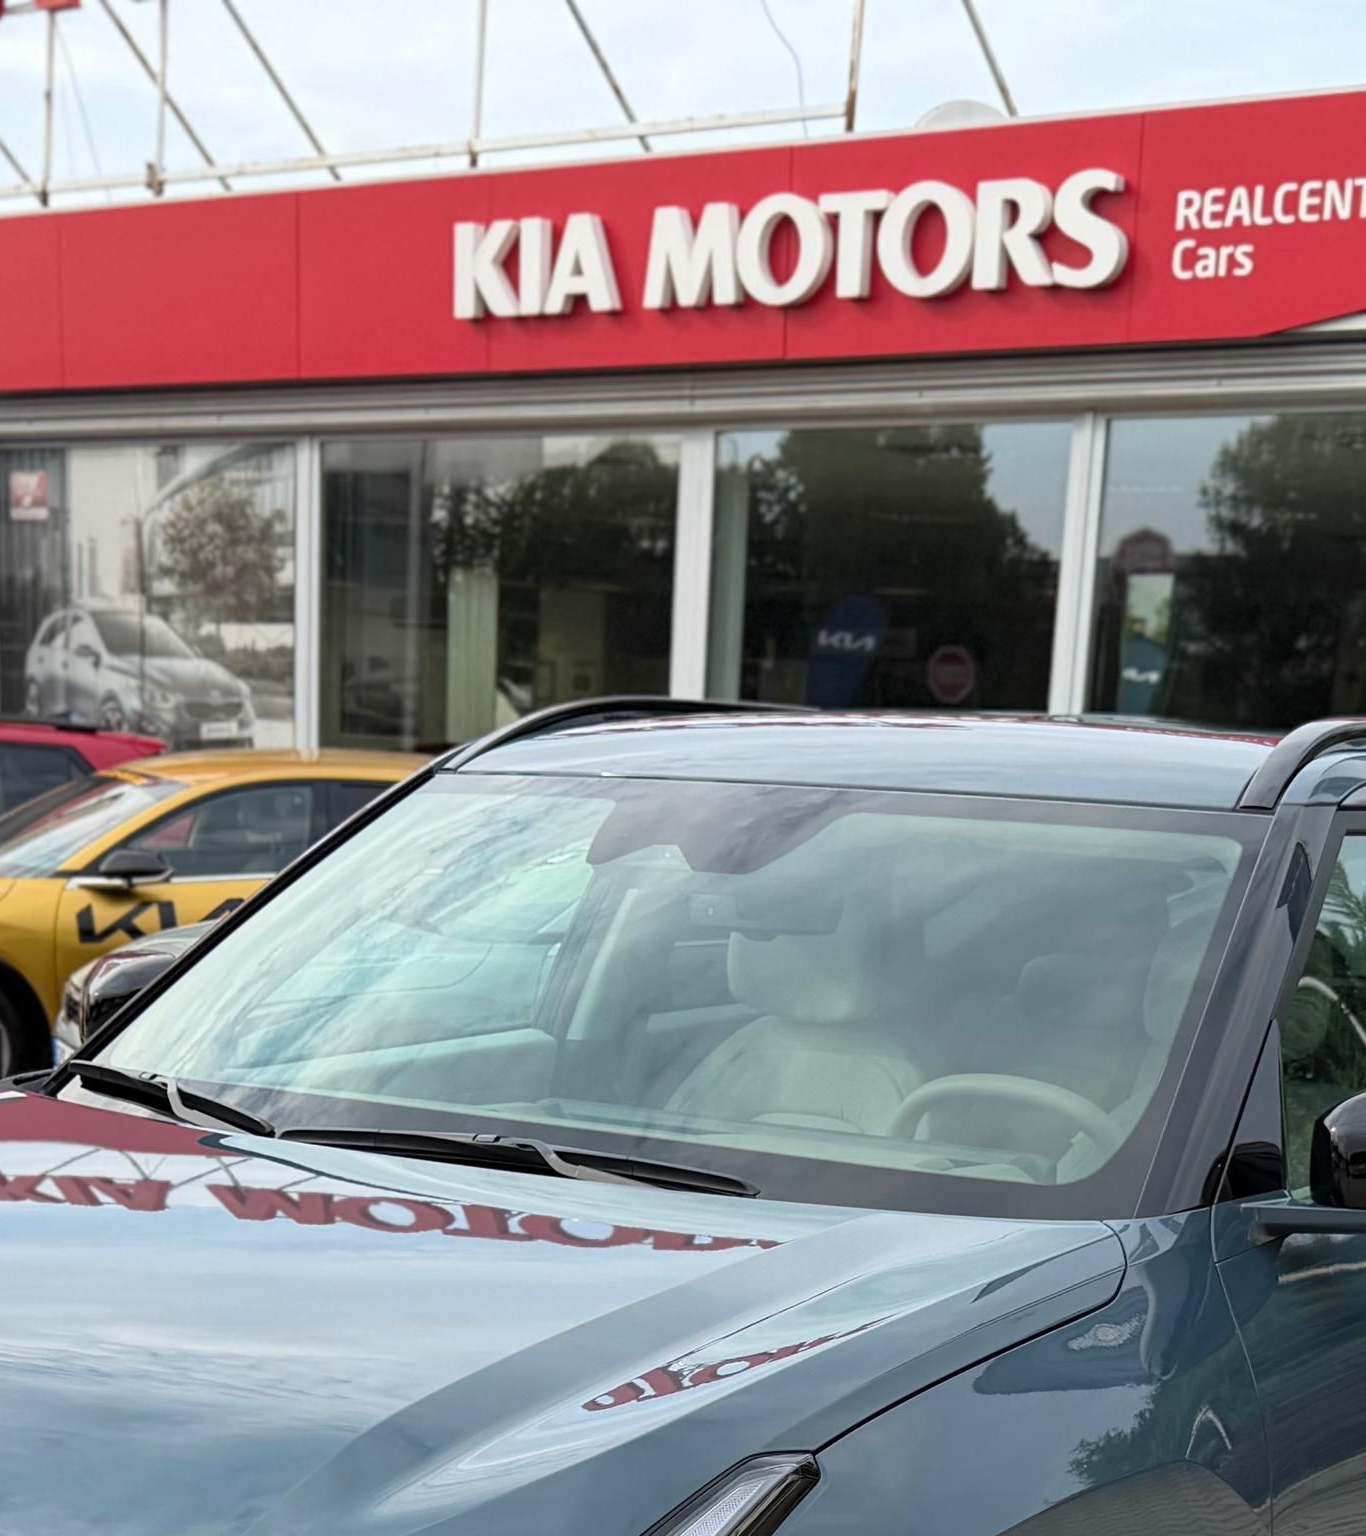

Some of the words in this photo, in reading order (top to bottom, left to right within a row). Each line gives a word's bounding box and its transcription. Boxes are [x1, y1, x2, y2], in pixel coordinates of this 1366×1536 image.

[453, 211, 623, 321] KIA
[642, 167, 1129, 309] MOTORS
[1171, 239, 1254, 280] Cars
